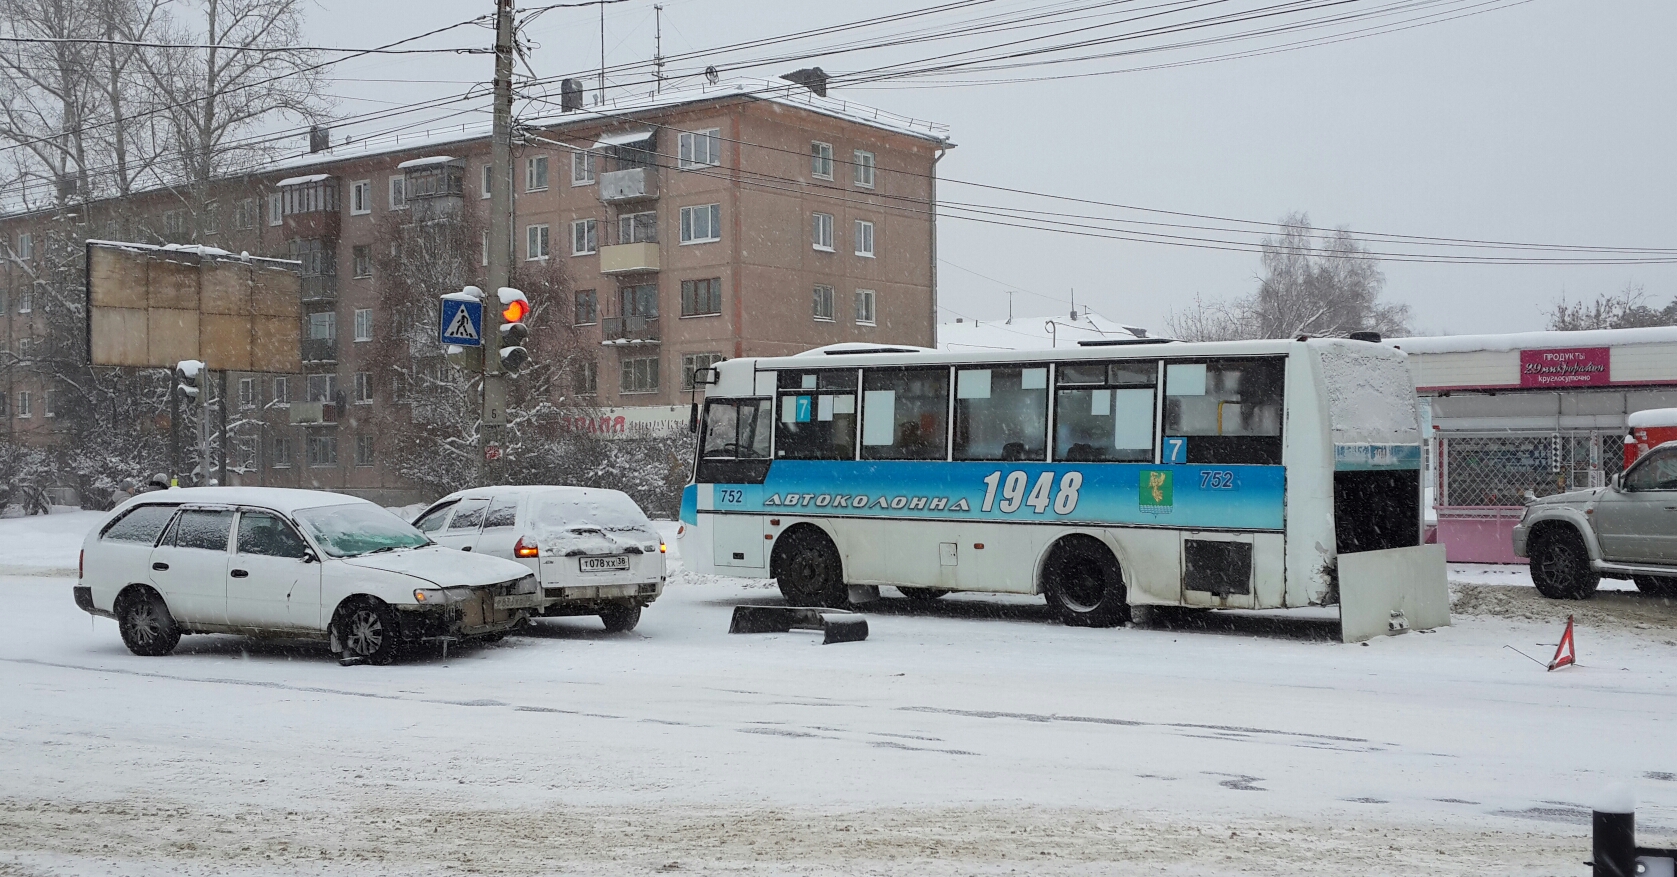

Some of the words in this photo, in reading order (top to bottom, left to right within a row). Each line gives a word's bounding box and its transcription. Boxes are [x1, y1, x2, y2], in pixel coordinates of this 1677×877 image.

[1543, 353, 1586, 361] ПРОДУКТЫ
[1538, 375, 1591, 383] круглосуточно
[799, 399, 808, 418] 7
[1169, 440, 1182, 460] 7
[1201, 471, 1234, 488] 752
[721, 490, 743, 503] 752
[763, 493, 971, 512] АВТОКОЛОННА
[981, 470, 1084, 515] 1948
